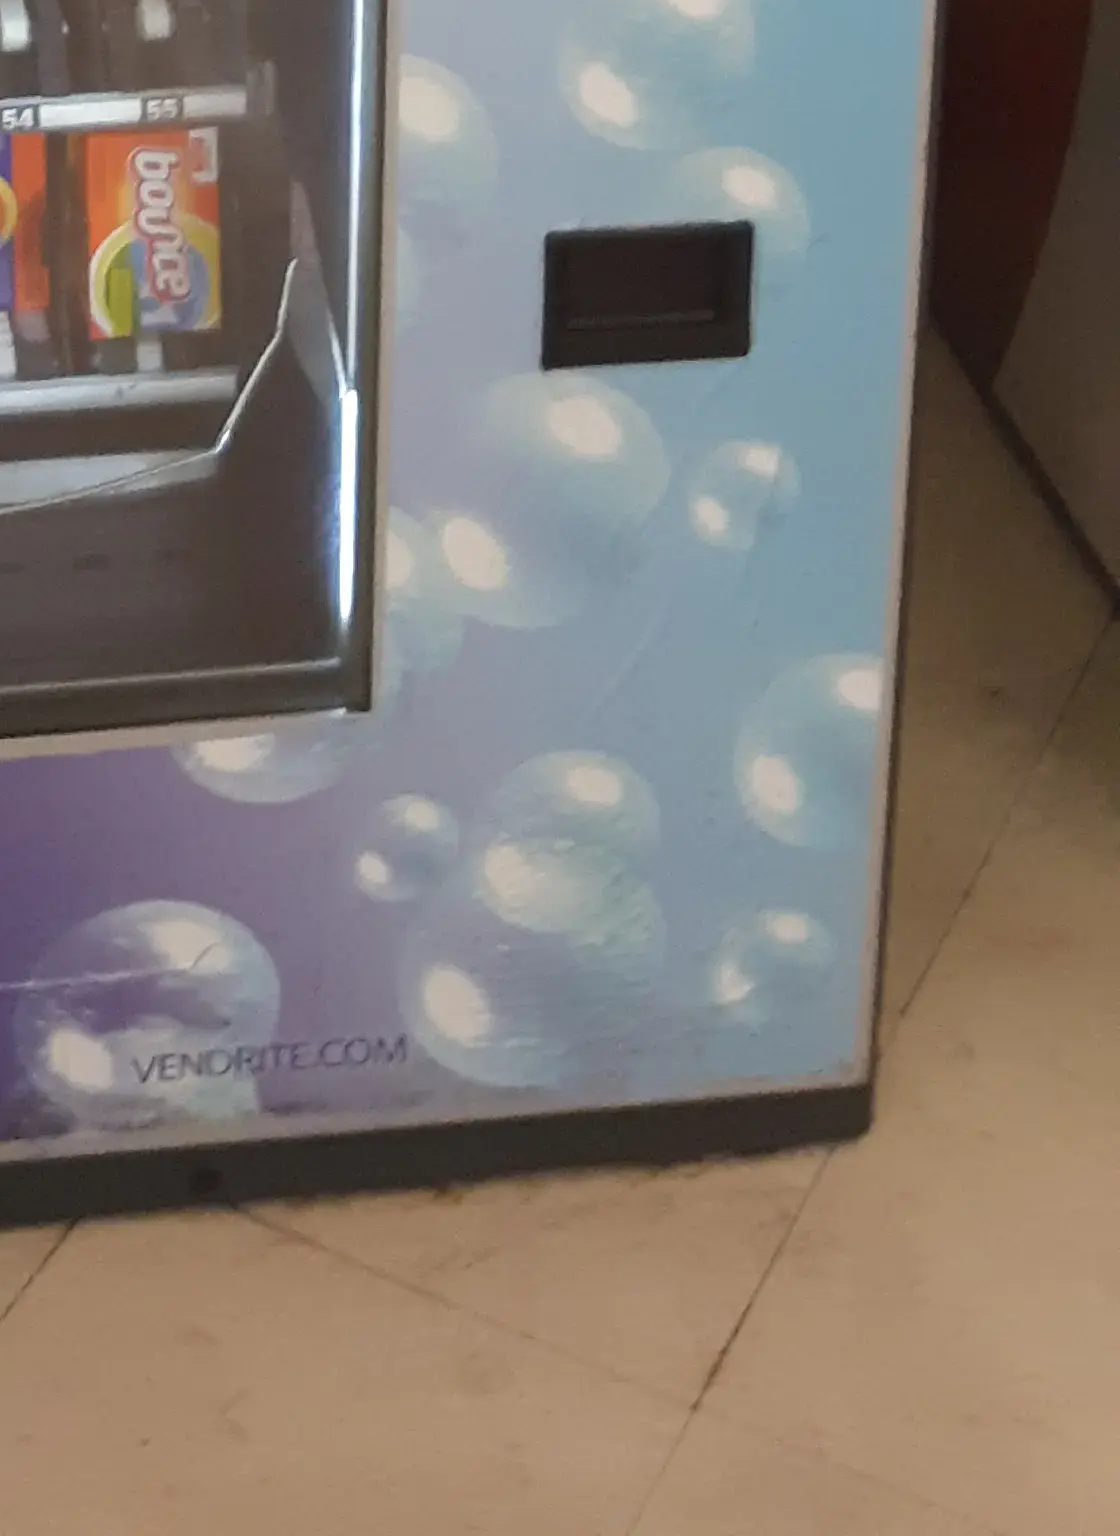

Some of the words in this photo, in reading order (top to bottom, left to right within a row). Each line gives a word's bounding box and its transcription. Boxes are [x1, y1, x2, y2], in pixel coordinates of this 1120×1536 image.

[2, 108, 35, 128] 54
[145, 98, 179, 120] 55
[135, 149, 191, 298] bounce
[130, 1032, 408, 1084] VENDRITE.COM
